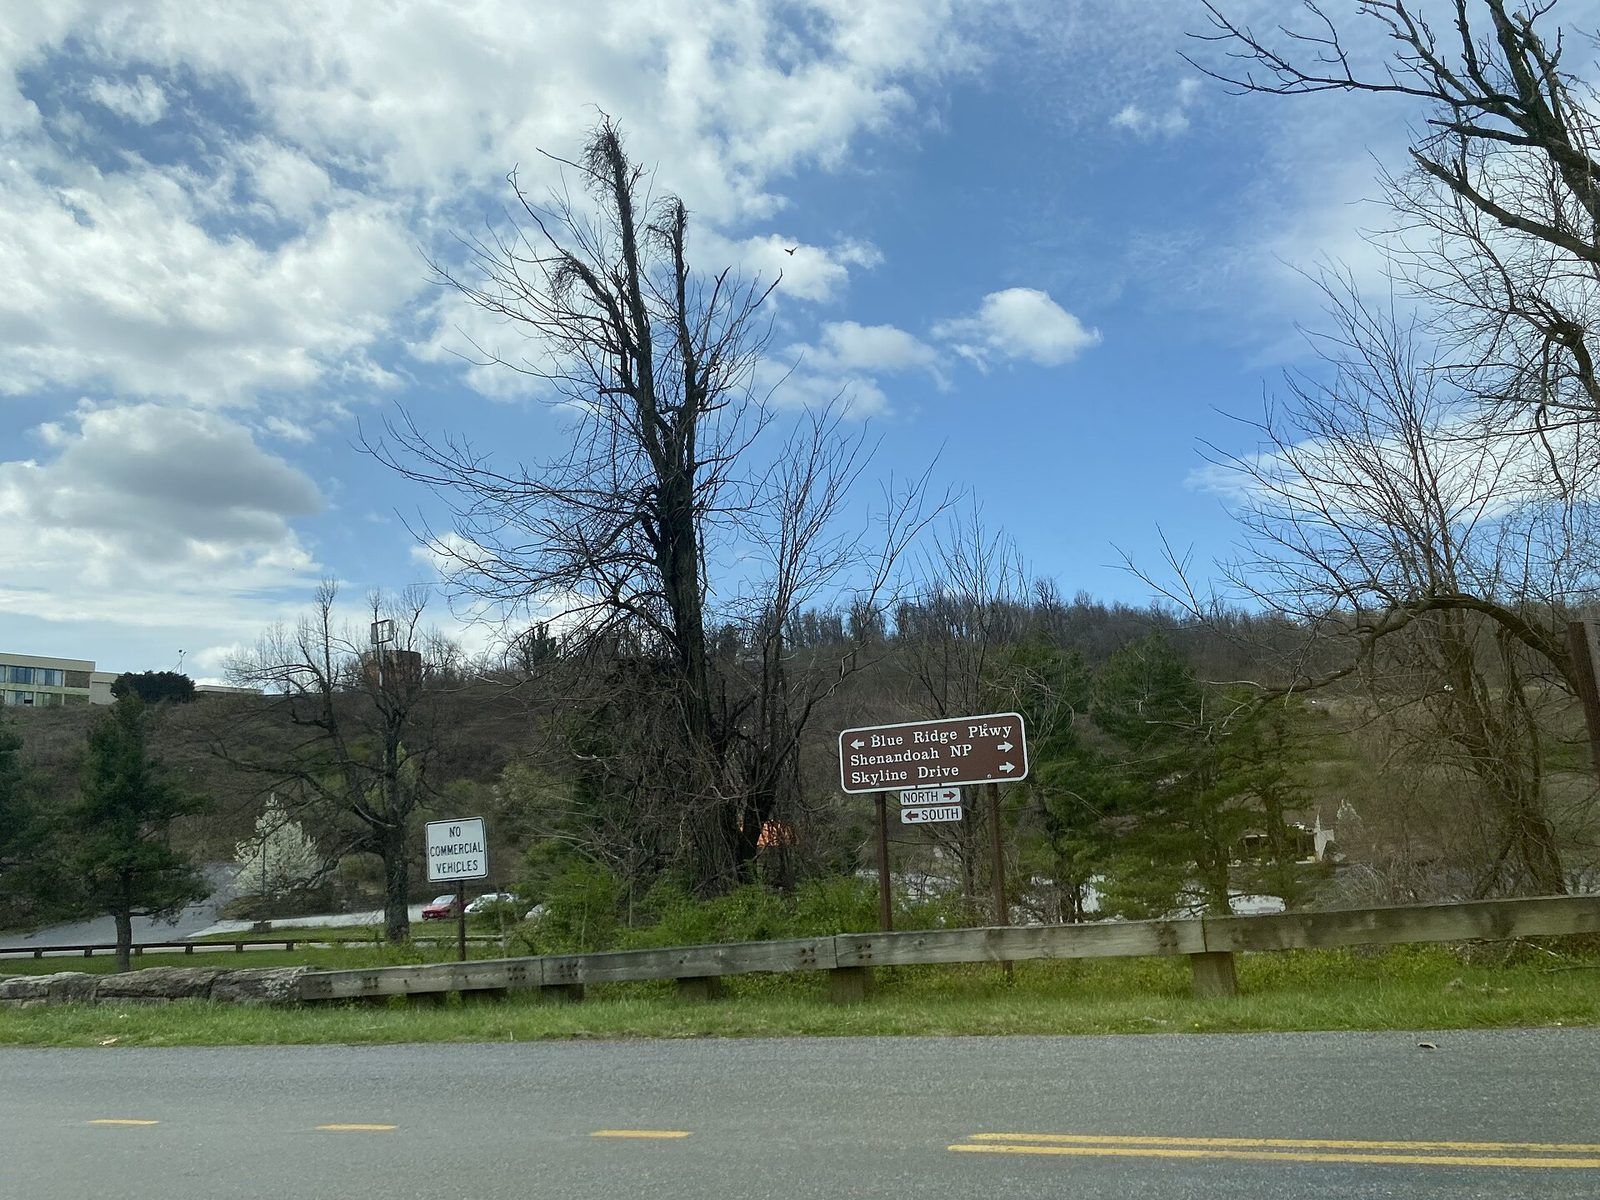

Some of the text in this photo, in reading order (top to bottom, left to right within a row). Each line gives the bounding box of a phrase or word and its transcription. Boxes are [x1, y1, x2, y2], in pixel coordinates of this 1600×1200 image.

[871, 724, 1012, 748] Blue Ridge Pkwy
[850, 744, 972, 766] Shenandoah NP
[851, 765, 959, 786] Skyline Drive
[903, 791, 938, 803] NORTH
[921, 808, 959, 821] SOUTH
[449, 826, 461, 838] NO
[430, 842, 483, 857] COMMERCIAL
[436, 860, 479, 874] VEHICLES
